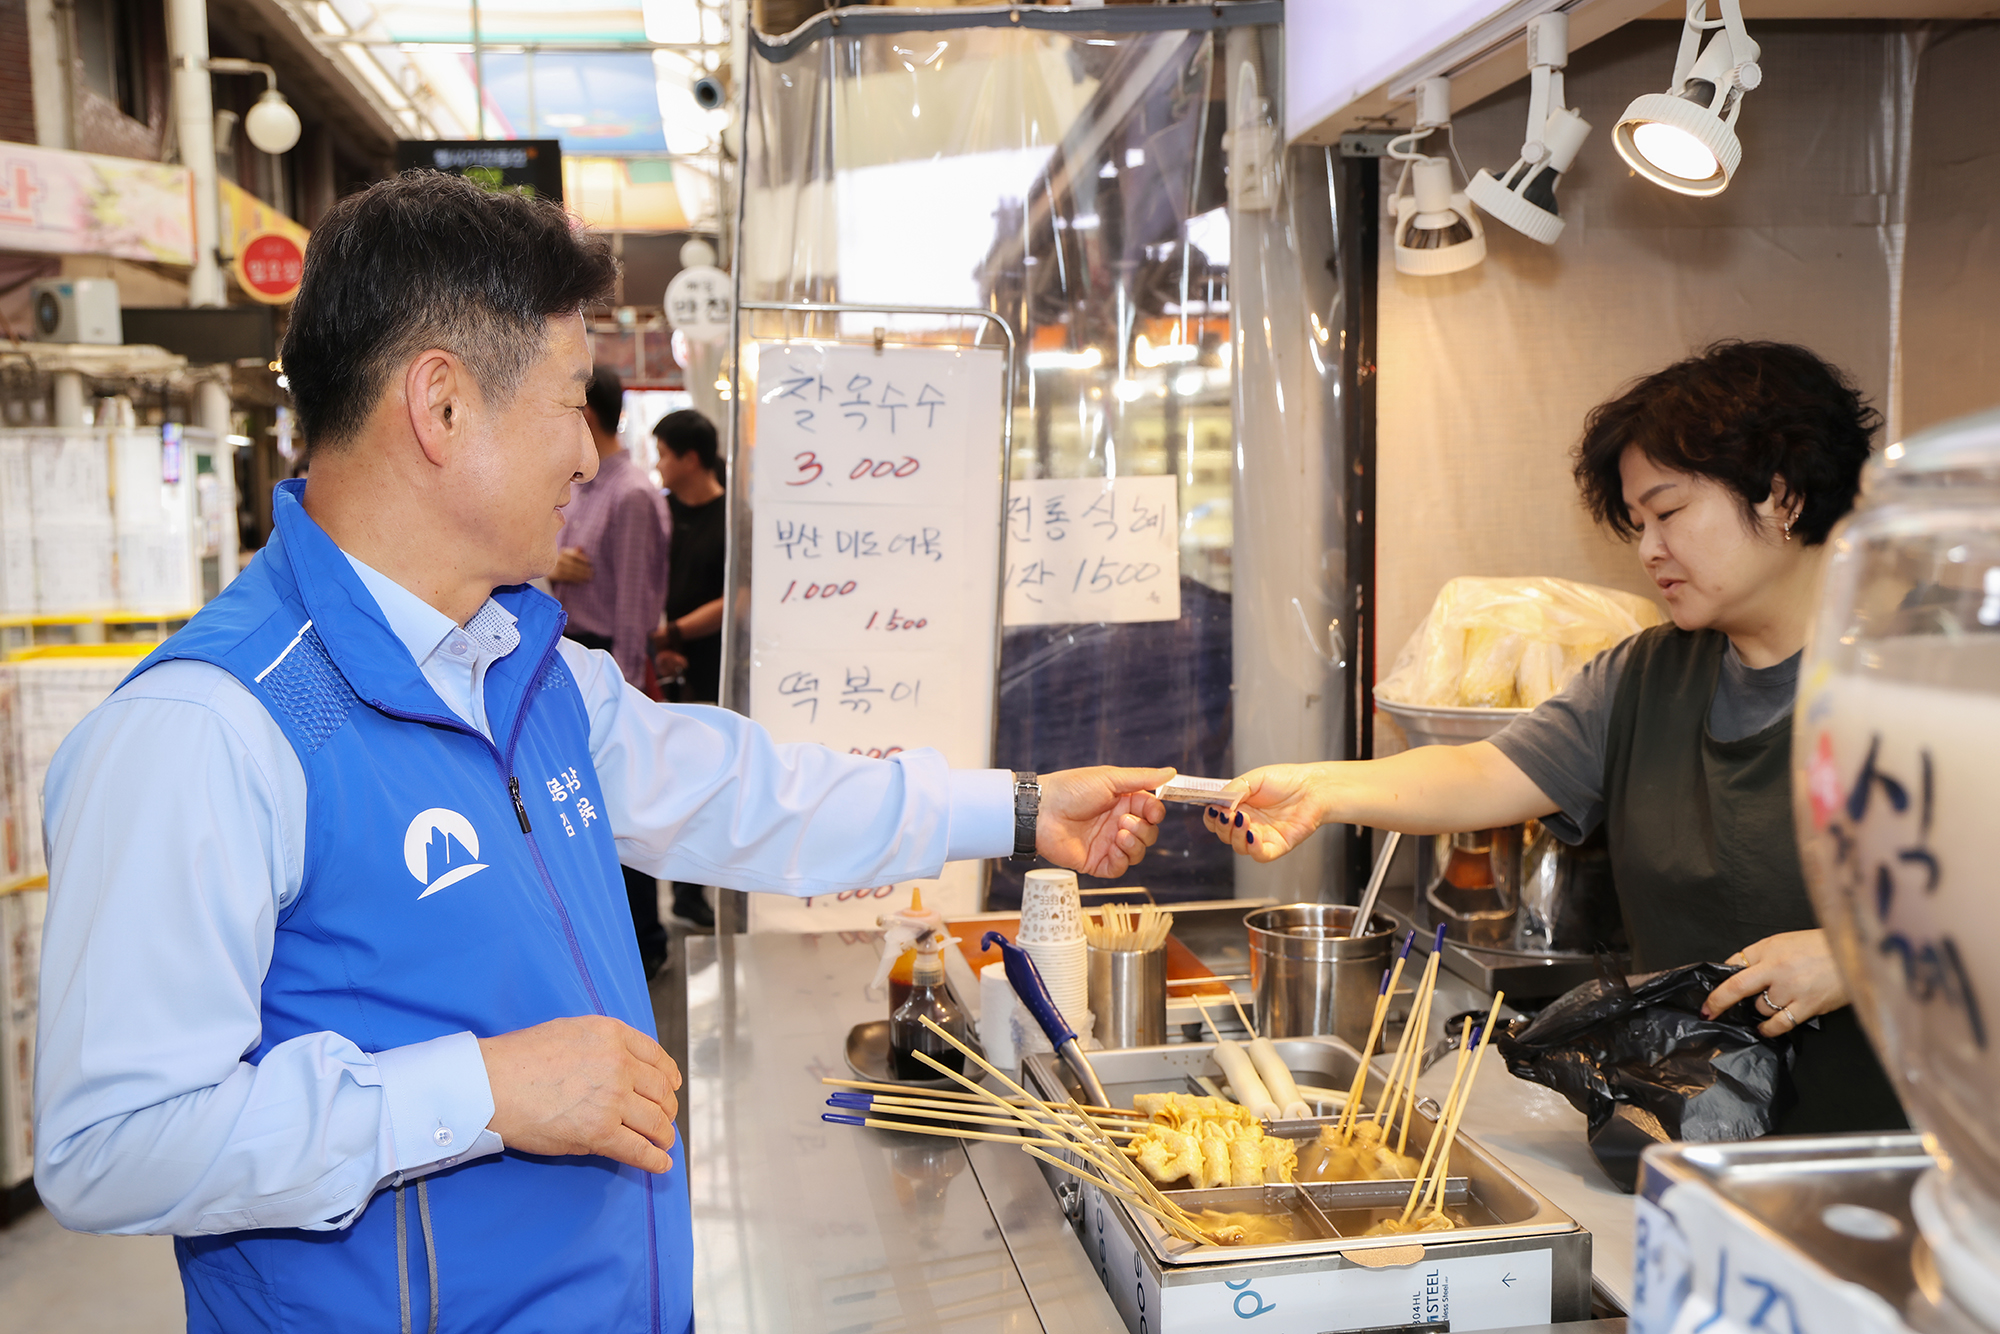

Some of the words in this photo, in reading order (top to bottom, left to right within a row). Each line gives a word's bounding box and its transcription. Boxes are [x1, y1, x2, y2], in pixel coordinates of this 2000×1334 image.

[779, 364, 946, 434] 찰옥수수
[774, 519, 823, 560] 부산
[1072, 556, 1161, 594] 1500
